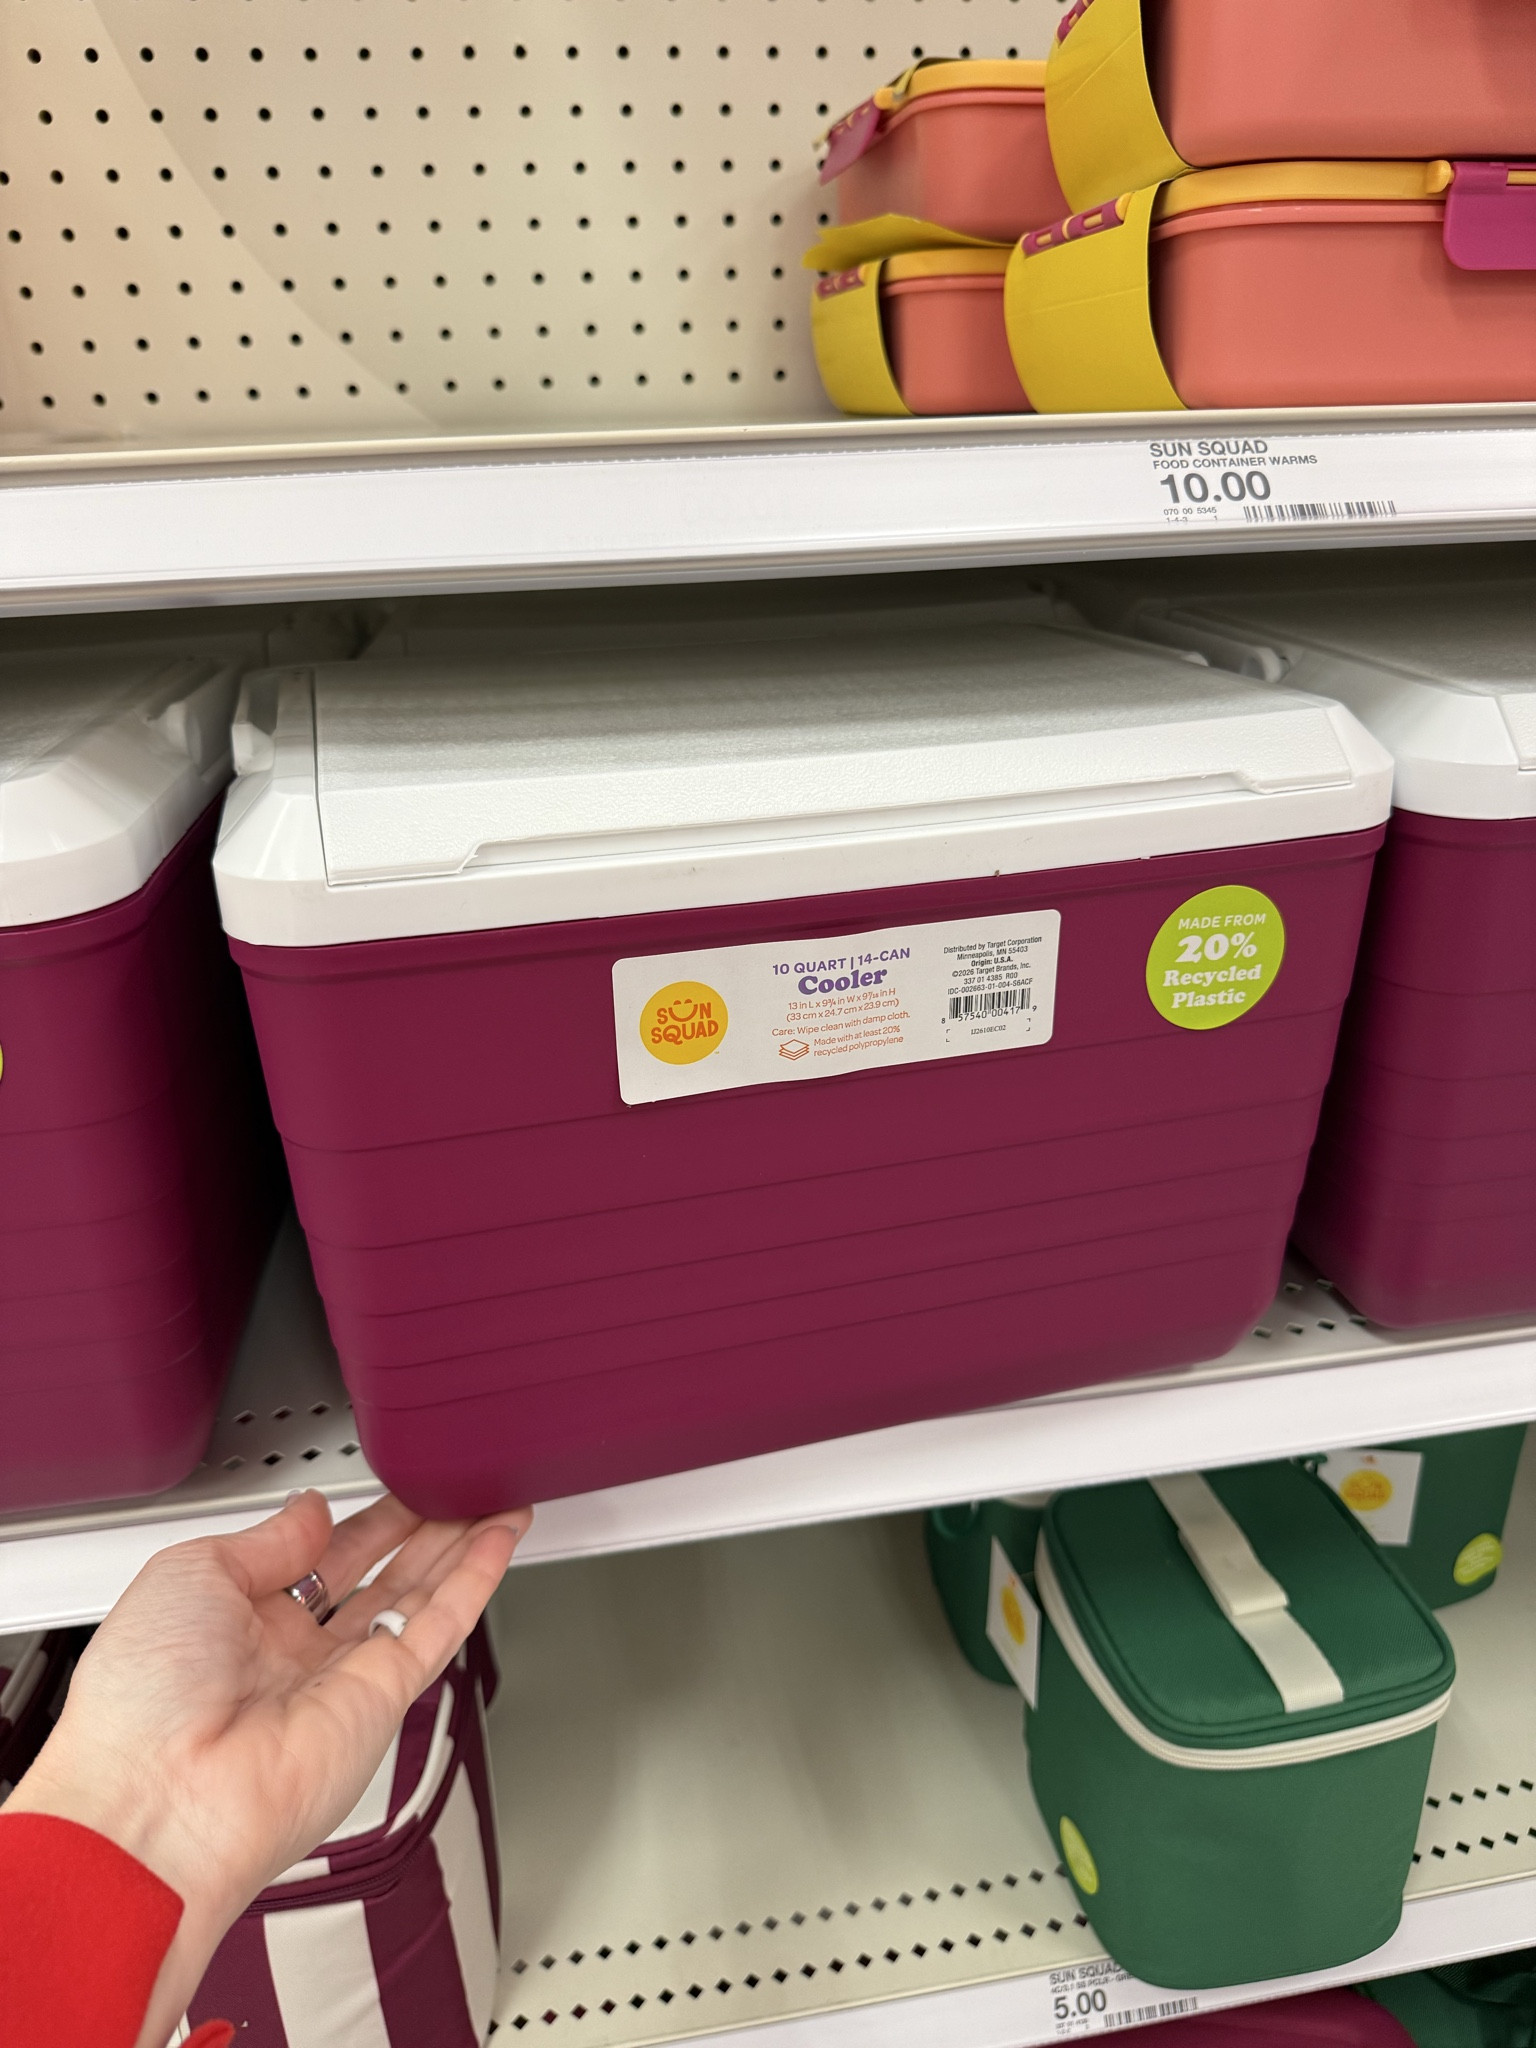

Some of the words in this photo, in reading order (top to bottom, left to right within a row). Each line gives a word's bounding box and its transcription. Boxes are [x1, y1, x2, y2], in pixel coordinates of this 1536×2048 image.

[1150, 442, 1192, 458] SUN
[1198, 440, 1268, 456] SQUAD
[1153, 459, 1189, 470] FOOD
[1193, 456, 1267, 469] CONTAINER
[1268, 454, 1318, 466] WARMS
[1160, 470, 1271, 504] 10.00
[1163, 508, 1179, 516] 070
[1182, 507, 1193, 515] 00
[1196, 506, 1217, 515] 5345
[1178, 915, 1221, 930] MADE
[1224, 912, 1267, 928] FROM
[943, 943, 977, 954] Distributed
[978, 942, 986, 951] by
[987, 940, 1006, 950] Target
[1007, 936, 1042, 947] Corporation
[956, 950, 995, 960] Minneapolis,
[996, 948, 1007, 956] MN
[1008, 945, 1028, 954] 55403
[1175, 931, 1258, 963] 20%
[772, 963, 790, 975] 10
[793, 958, 847, 974] QUART
[857, 947, 911, 966] 14-CAN
[970, 959, 993, 967] Origin:
[993, 956, 1013, 964] U.S.A.
[976, 966, 995, 975] Target
[996, 963, 1019, 972] Brands,
[1020, 961, 1031, 969] Inc.
[798, 969, 888, 995] Cooler
[963, 977, 976, 985] 337
[986, 973, 1003, 982] 4385
[1162, 964, 1262, 988] Recycled
[788, 1001, 798, 1010] 13
[799, 1001, 807, 1009] in
[837, 997, 845, 1005] in
[846, 994, 856, 1003] W
[879, 989, 888, 997] in
[888, 987, 896, 996] H
[1171, 988, 1247, 1009] Plastic
[657, 999, 712, 1025] SUN
[786, 1012, 801, 1023] (33
[802, 1012, 817, 1020] cm
[824, 1007, 843, 1018] 24.7
[843, 1006, 857, 1015] cm
[863, 1000, 881, 1011] 23.9
[881, 997, 900, 1008] cm)
[958, 1010, 988, 1022] 57540
[991, 1006, 1021, 1018] 00417
[651, 1019, 719, 1046] SQUAD
[771, 1027, 796, 1037] Care:
[797, 1025, 819, 1036] Wipe
[820, 1022, 844, 1032] clean
[844, 1018, 861, 1028] with
[862, 1014, 886, 1025] damp
[887, 1010, 911, 1021] cloth.
[813, 1036, 836, 1046] Made
[837, 1033, 854, 1043] with
[854, 1031, 863, 1040] at
[863, 1028, 882, 1038] least
[882, 1024, 901, 1035] 20%
[813, 1044, 848, 1057] recycled
[848, 1035, 904, 1052] polypropylene
[1049, 1967, 1076, 1985] SUN
[1054, 1988, 1107, 2020] 5.00
